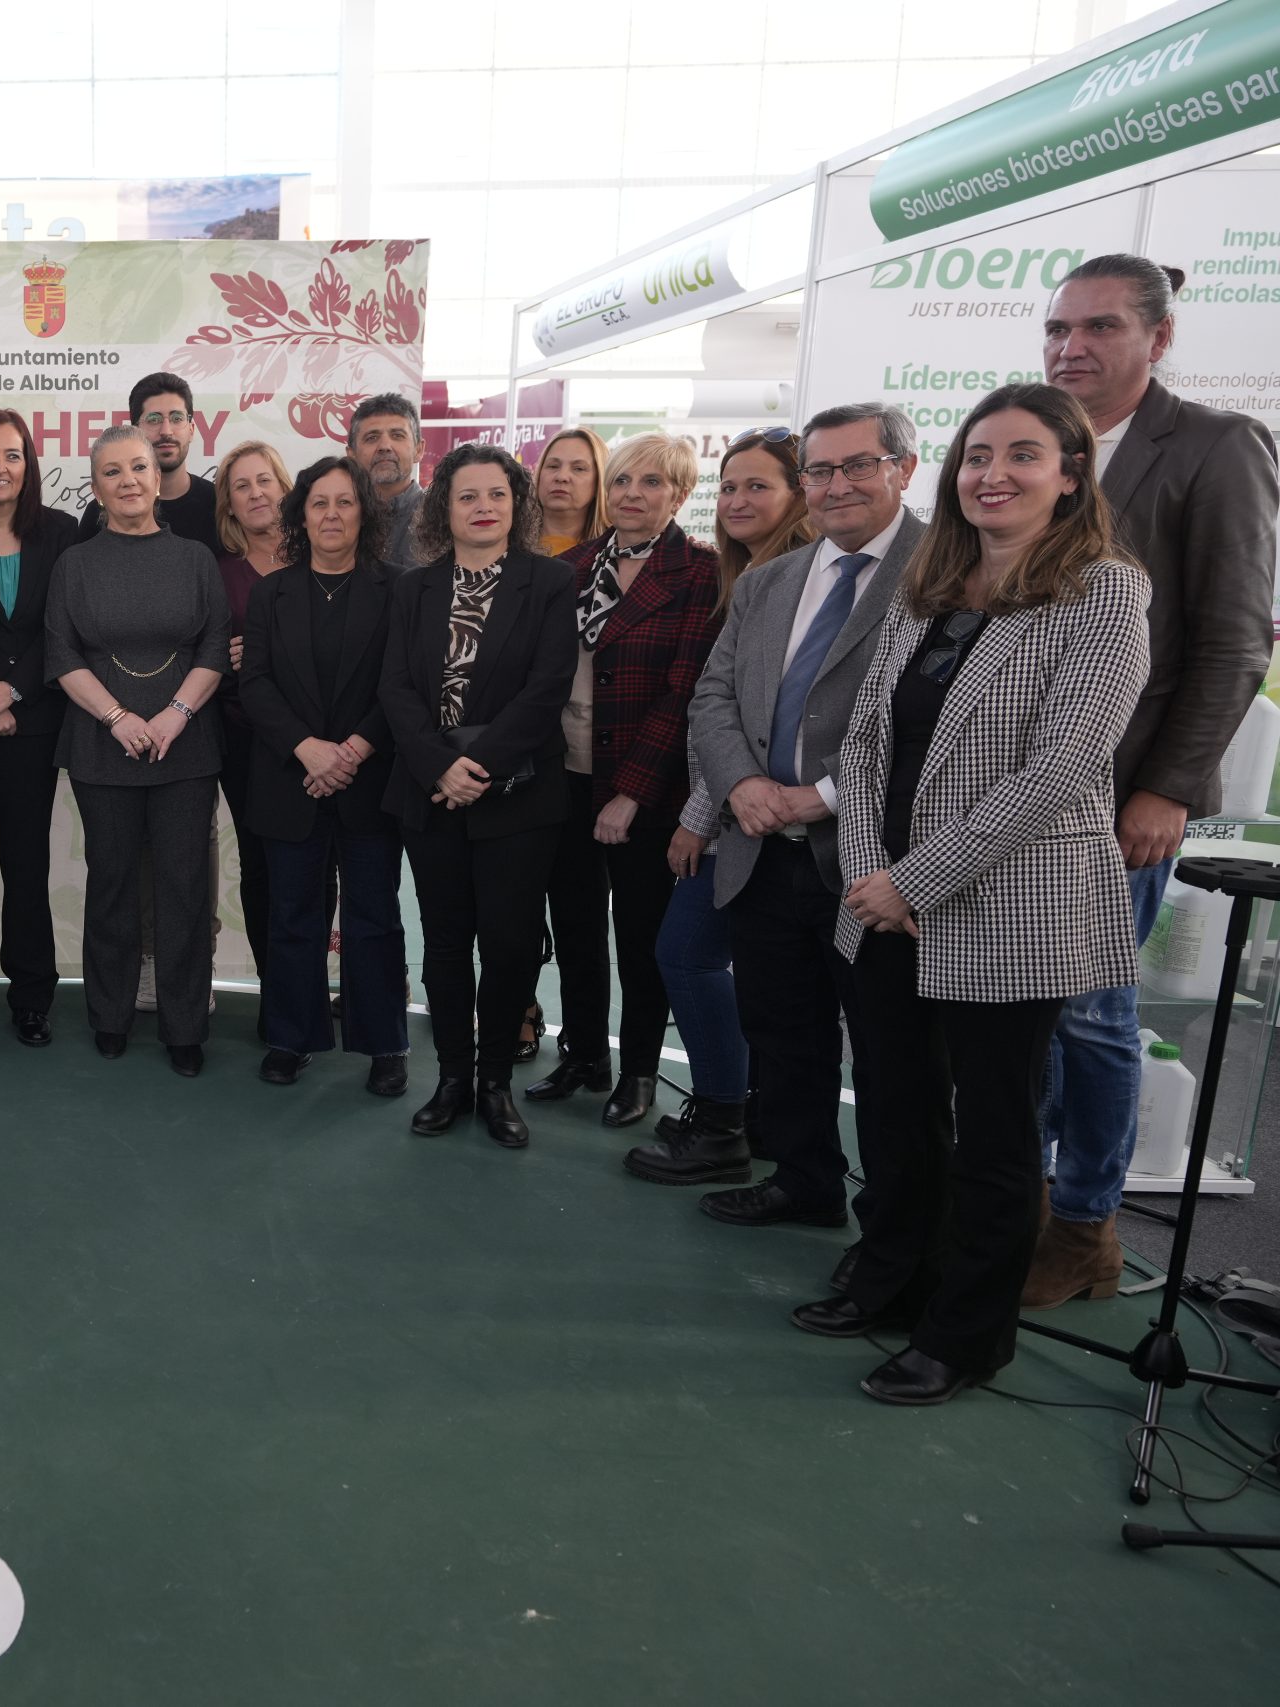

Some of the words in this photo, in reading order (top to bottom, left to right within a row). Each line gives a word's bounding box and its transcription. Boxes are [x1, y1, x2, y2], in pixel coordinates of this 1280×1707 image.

[1068, 27, 1210, 112] Bioera
[900, 165, 1010, 221] Soluciones
[1008, 90, 1223, 183] biotecnológicas
[1225, 65, 1280, 115] par
[1223, 228, 1280, 250] Impu
[1178, 281, 1280, 303] ortícolas
[909, 302, 952, 318] JUST
[956, 302, 1035, 318] BIOTECH
[19, 374, 99, 391] Albuñol
[883, 362, 998, 391] Líderes
